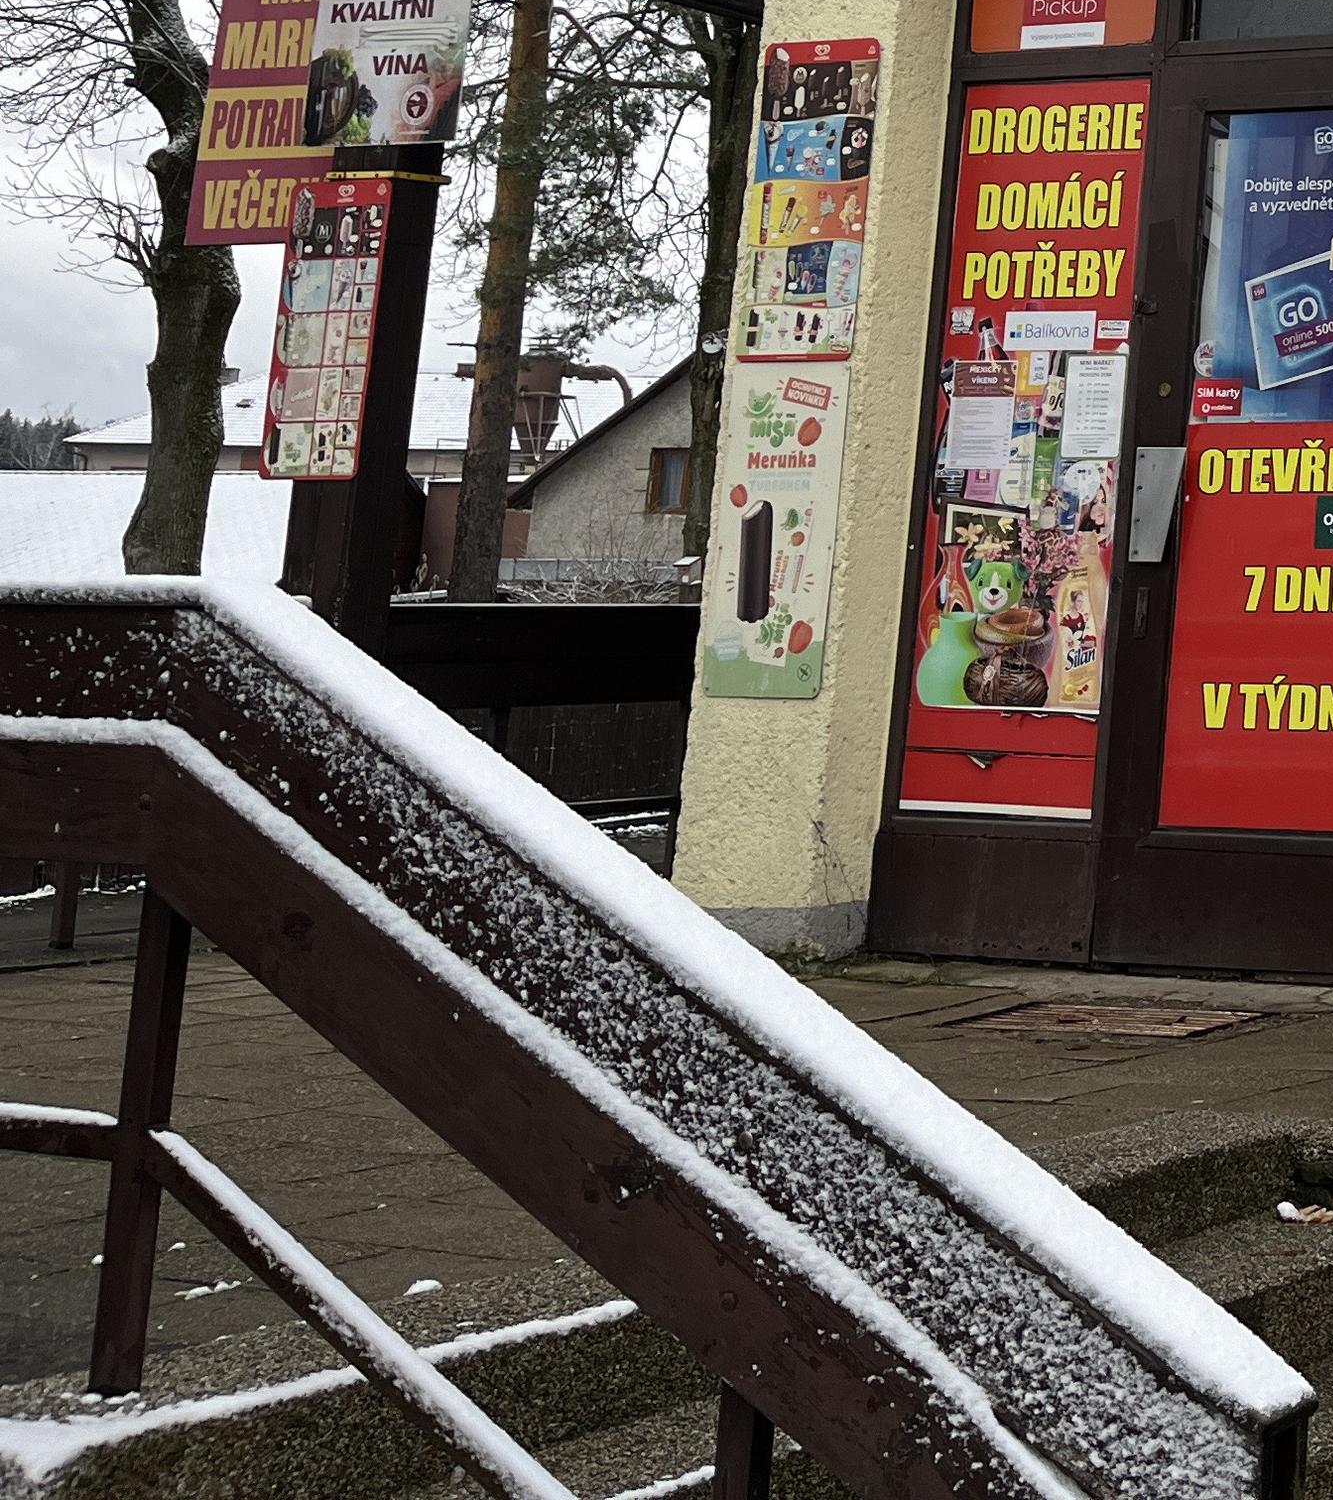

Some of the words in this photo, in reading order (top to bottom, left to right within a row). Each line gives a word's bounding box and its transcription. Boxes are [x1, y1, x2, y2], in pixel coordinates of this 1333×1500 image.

[372, 49, 429, 77] VÍNA
[968, 102, 1145, 155] DROGERIE
[1244, 178, 1293, 194] Dobijte
[975, 170, 1127, 232] DOMÁCÍ
[1249, 203, 1258, 213] a
[962, 240, 1126, 301] POTŘEBY
[1279, 296, 1319, 328] GO
[1024, 323, 1089, 339] Balíkovna
[1282, 329, 1313, 347] online
[1216, 388, 1240, 400] karty
[1244, 566, 1266, 613] 7
[1065, 648, 1095, 671] Silan
[1202, 683, 1231, 730] V
